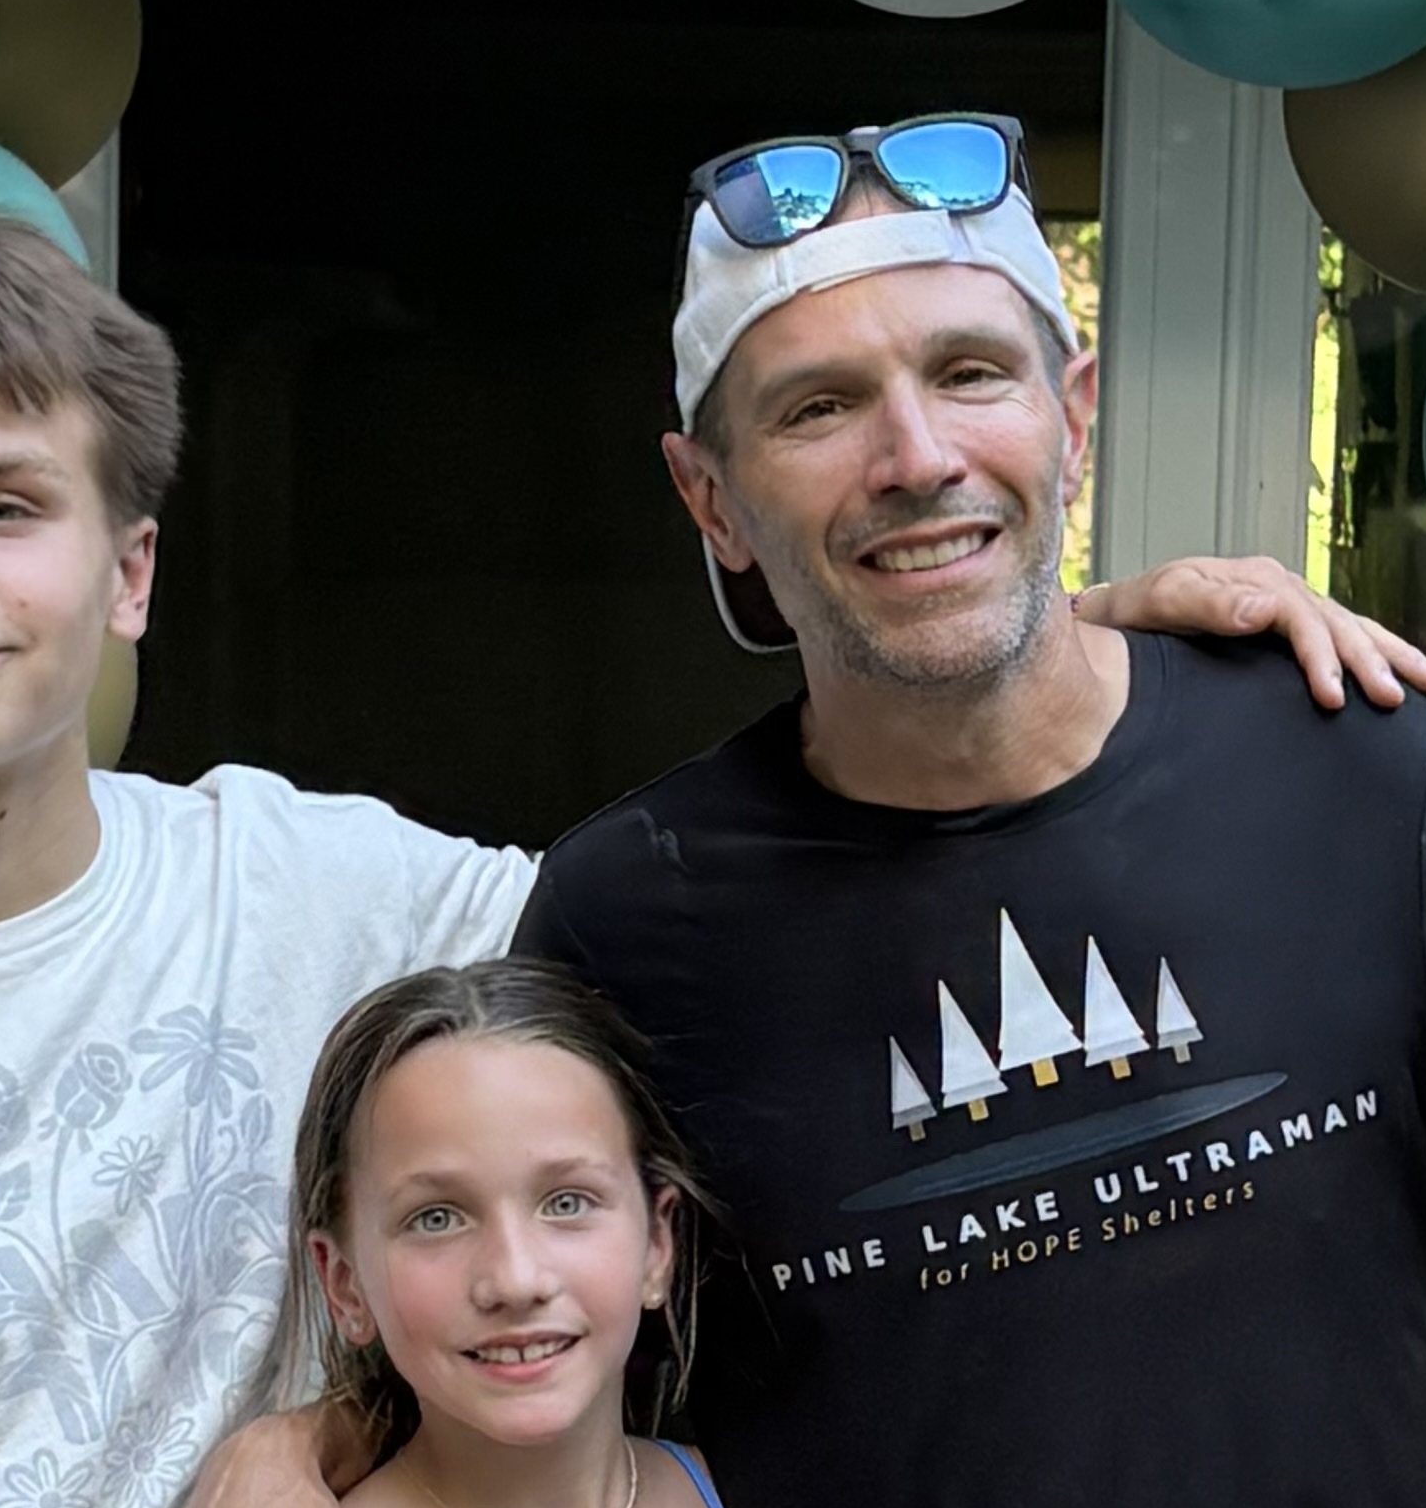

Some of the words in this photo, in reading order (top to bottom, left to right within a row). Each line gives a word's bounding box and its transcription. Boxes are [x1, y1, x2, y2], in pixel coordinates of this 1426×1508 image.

[772, 1238, 886, 1291] PINE
[922, 1191, 1060, 1253] LAKE
[1093, 1090, 1377, 1204] ULTRAMAN
[920, 1262, 969, 1291] for
[991, 1227, 1083, 1271] HOPE
[1101, 1181, 1255, 1242] Shelters
